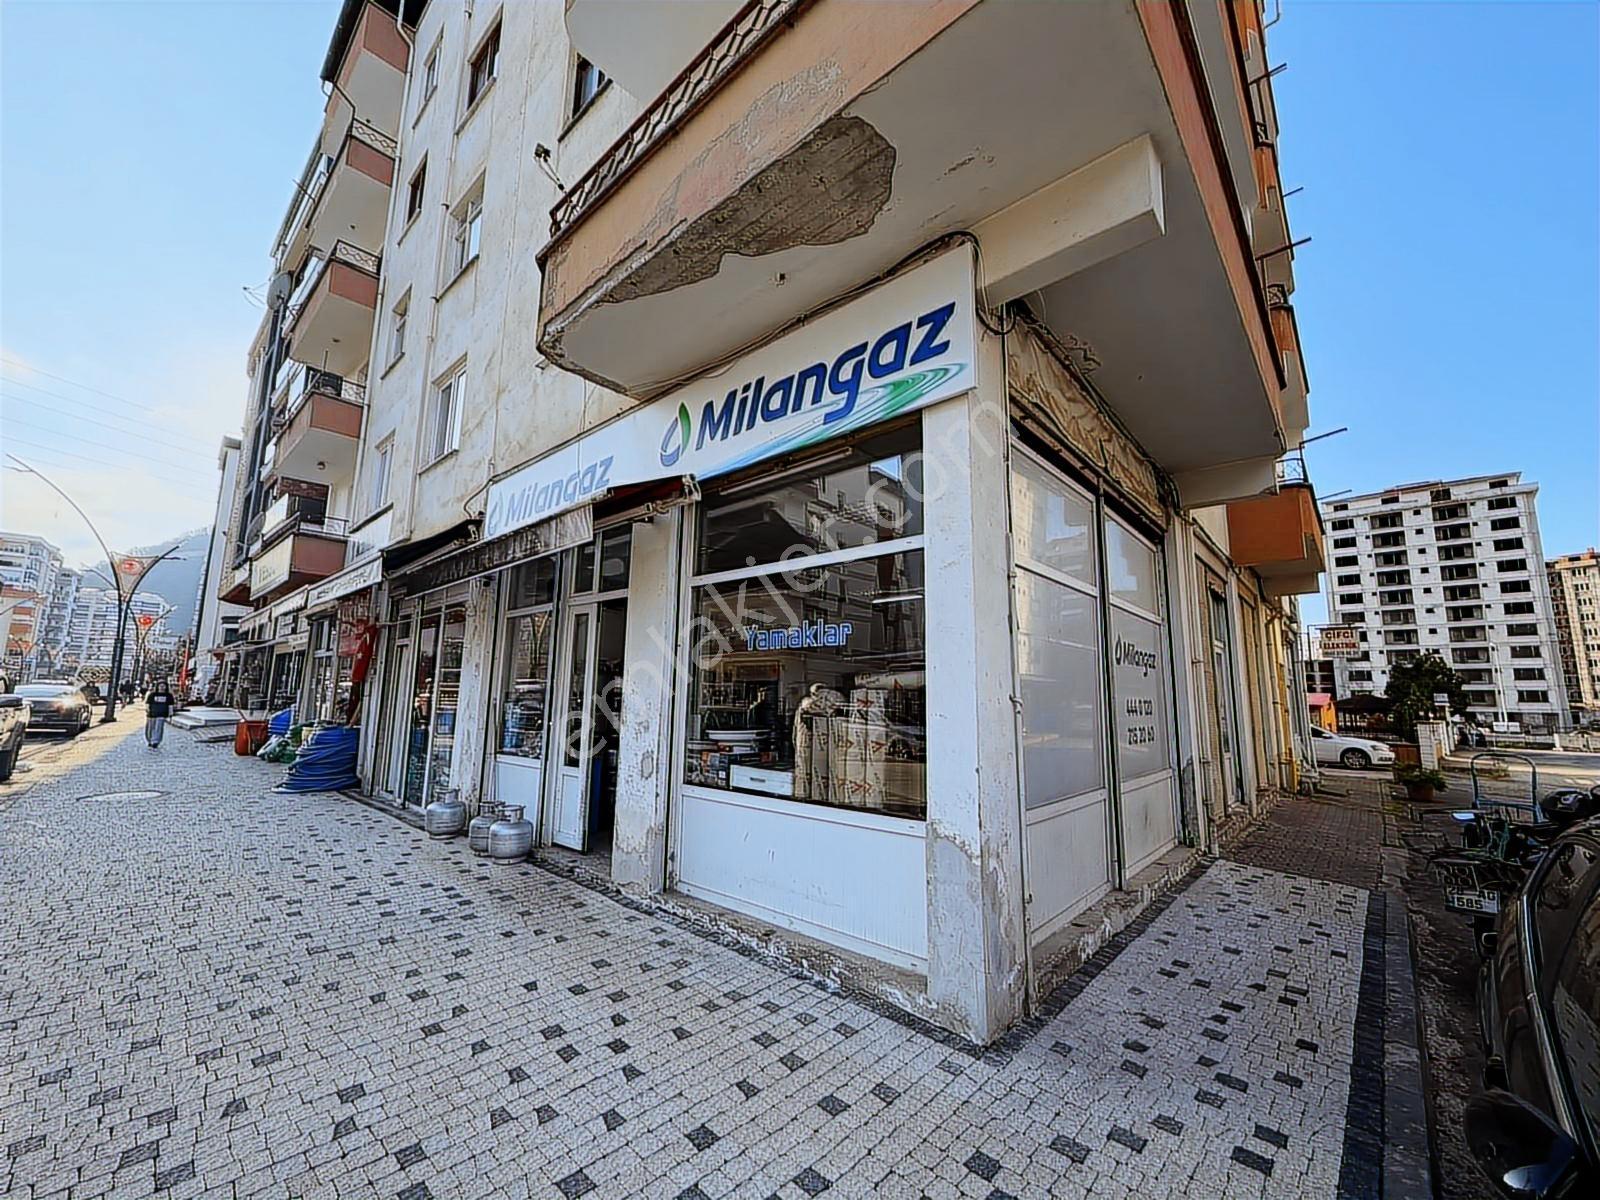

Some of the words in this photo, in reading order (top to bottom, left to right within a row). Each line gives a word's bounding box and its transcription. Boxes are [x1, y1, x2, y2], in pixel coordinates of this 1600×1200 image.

[696, 301, 956, 450] Milangaz
[505, 455, 614, 527] Milangaz
[743, 618, 853, 651] Yamaklar
[1123, 641, 1157, 677] Milangaz
